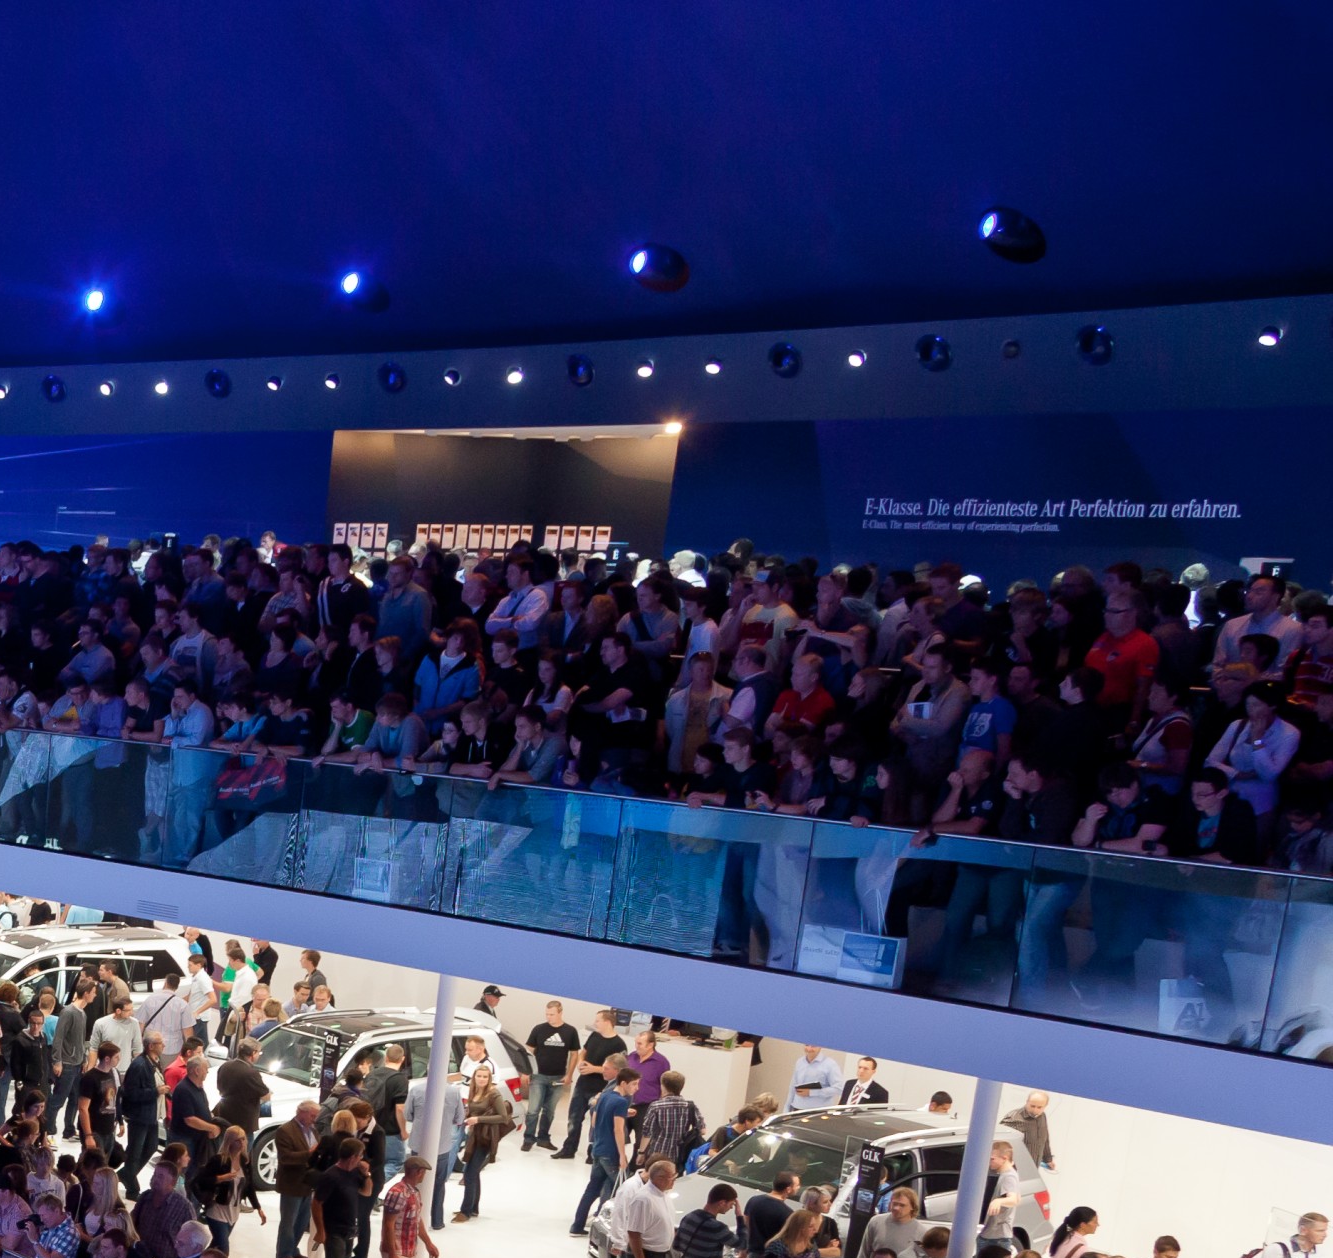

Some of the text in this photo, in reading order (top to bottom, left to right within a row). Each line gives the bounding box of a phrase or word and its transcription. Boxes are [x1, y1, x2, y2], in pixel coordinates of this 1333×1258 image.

[864, 498, 1242, 519] E-Klasse. Die effizienteste Art Perfektion zu erfahren.
[862, 520, 888, 530] E-Class.
[889, 520, 903, 530] The
[903, 521, 920, 530] most
[921, 521, 950, 530] efficient
[951, 522, 966, 532] way
[974, 521, 1021, 533] experiencing
[1020, 522, 1060, 533] perfection.
[325, 1034, 339, 1047] GLK
[862, 1149, 881, 1164] GLK
